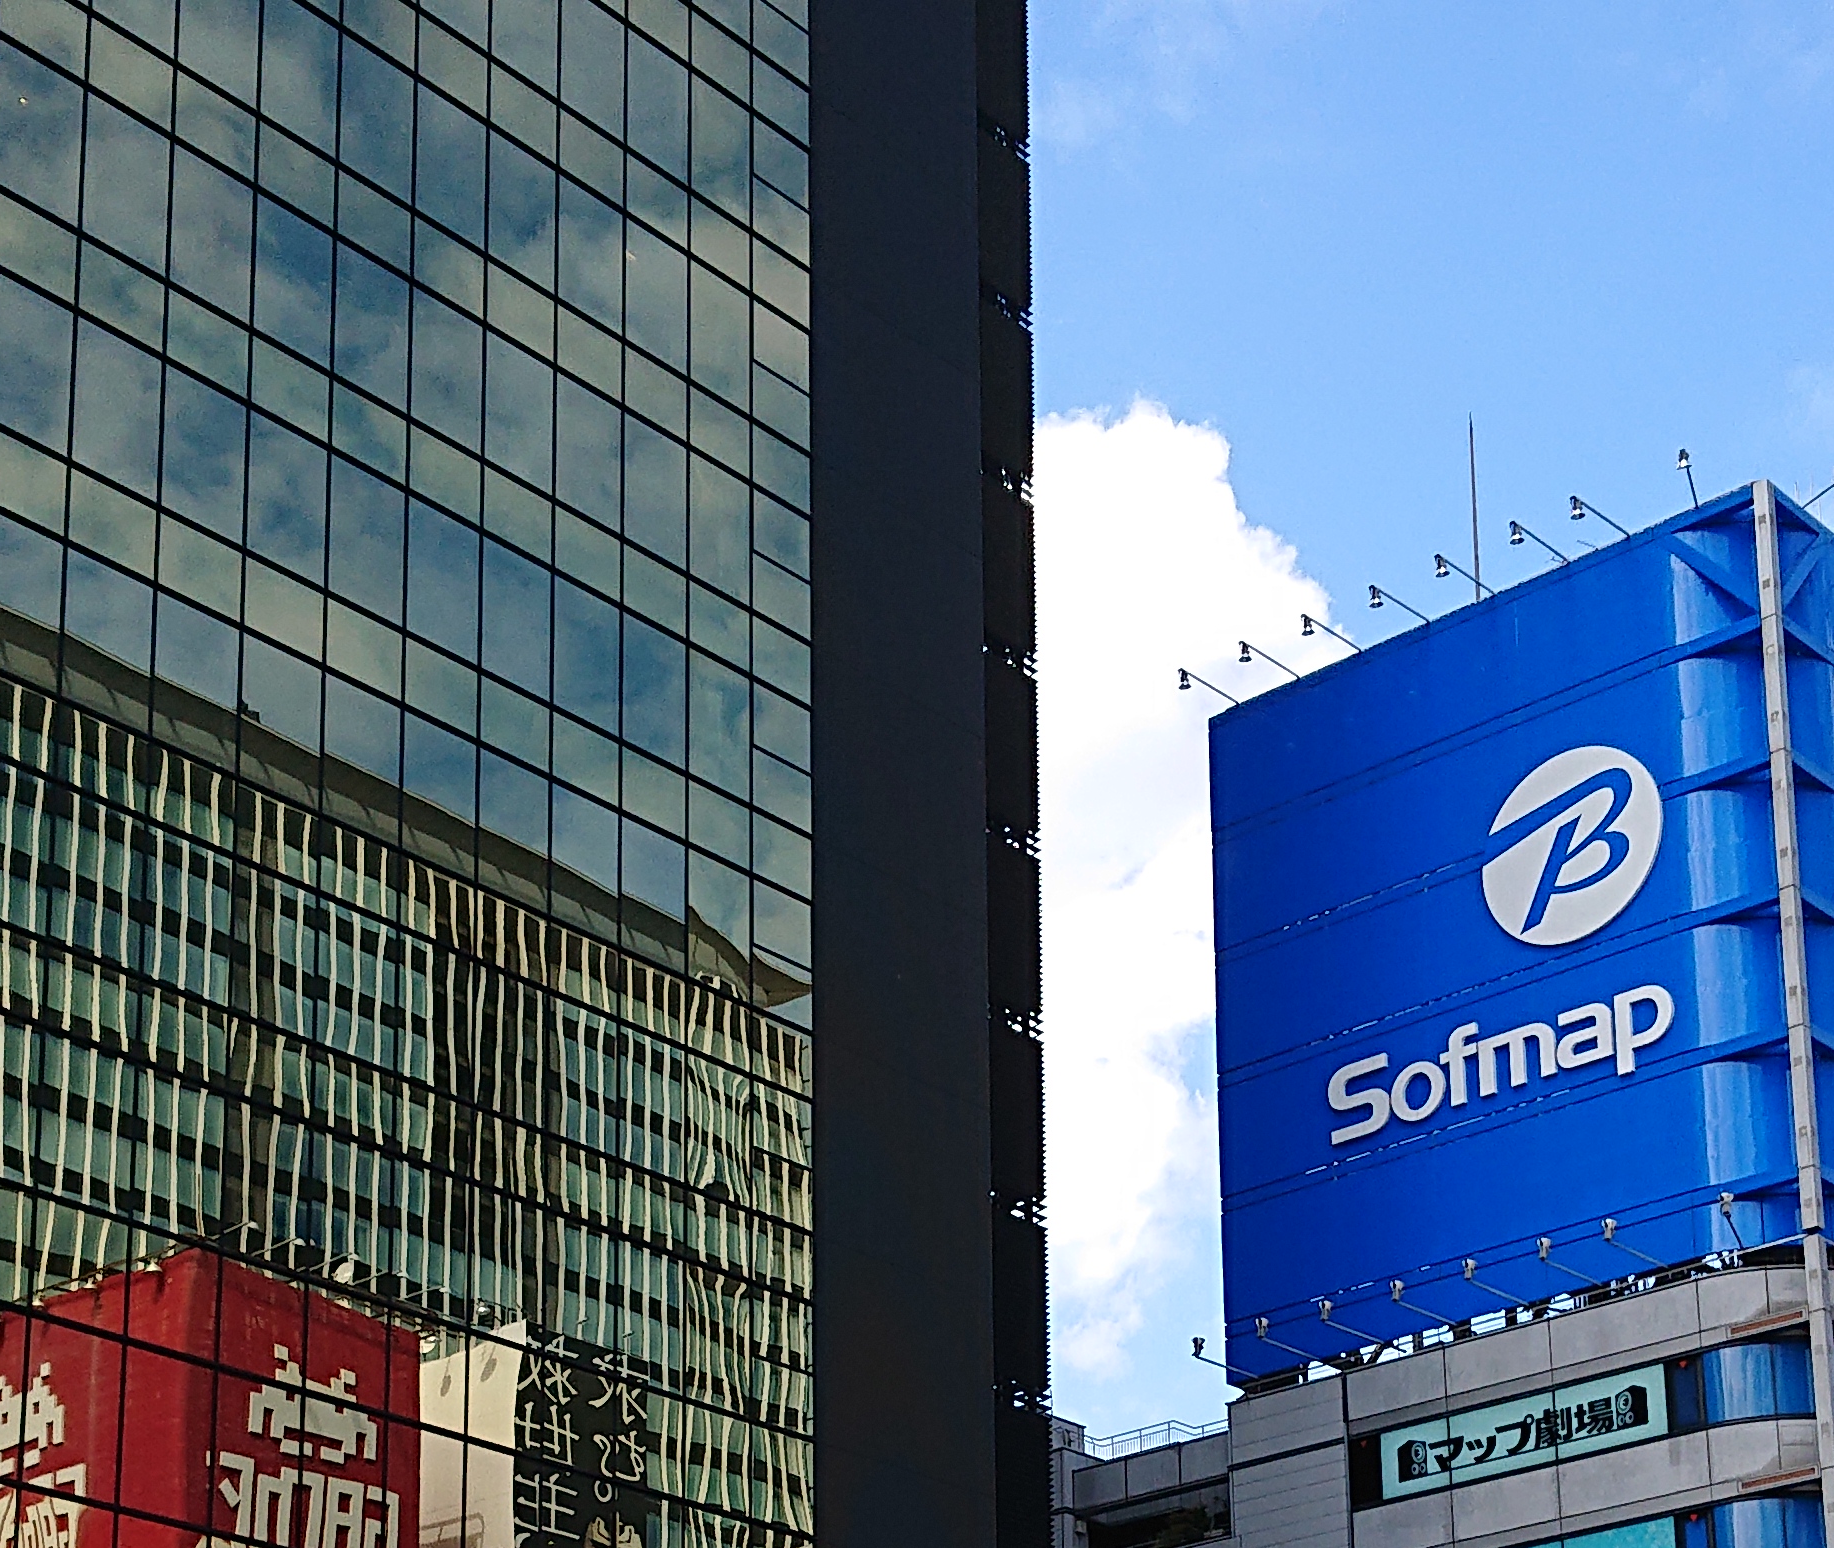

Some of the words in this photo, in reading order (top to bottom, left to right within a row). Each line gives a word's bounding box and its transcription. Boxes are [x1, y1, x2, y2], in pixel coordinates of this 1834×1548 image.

[1329, 983, 1675, 1145] Sofmap
[1428, 1396, 1614, 1472] マップ劇場
